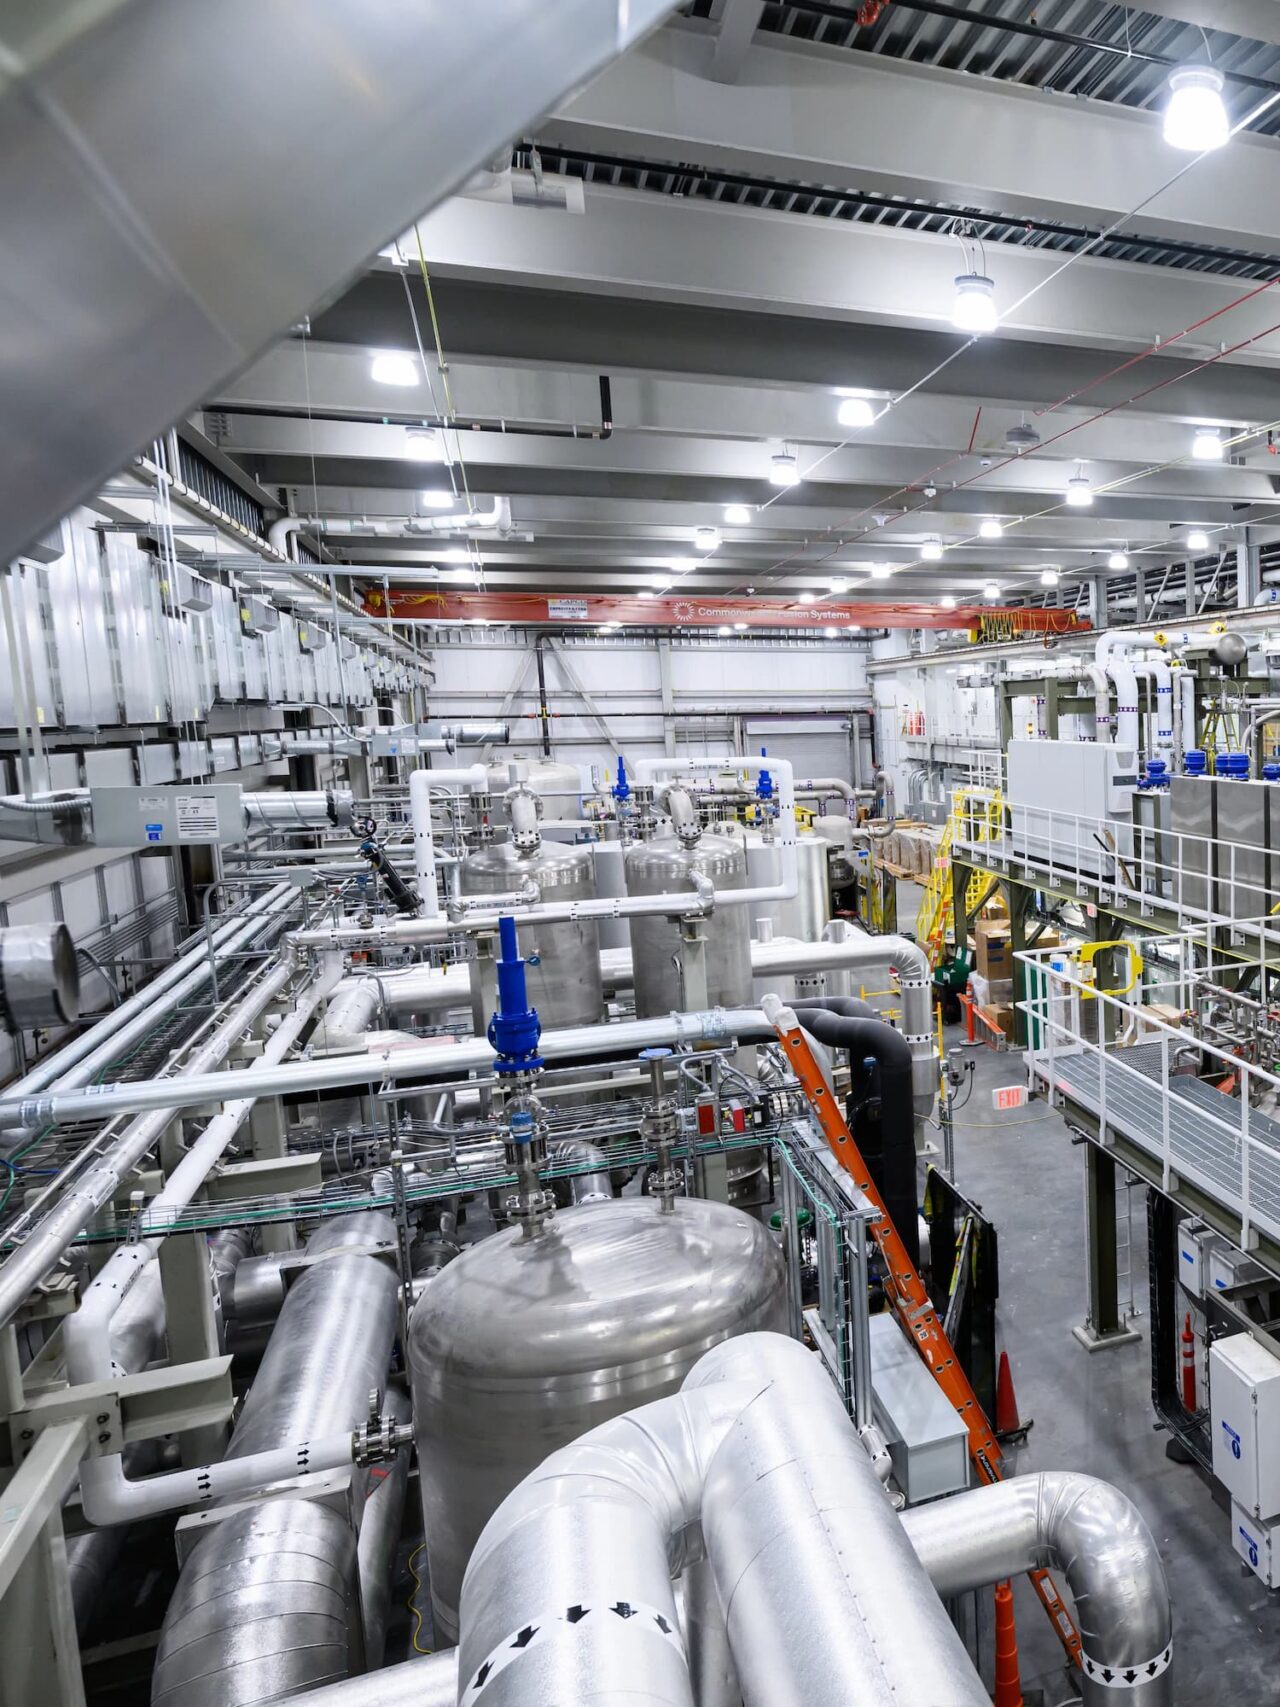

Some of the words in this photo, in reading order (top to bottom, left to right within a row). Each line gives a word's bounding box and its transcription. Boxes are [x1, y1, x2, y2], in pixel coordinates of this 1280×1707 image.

[698, 608, 777, 618] Commonw
[811, 610, 850, 621] Systems
[998, 1087, 1021, 1109] EXIT
